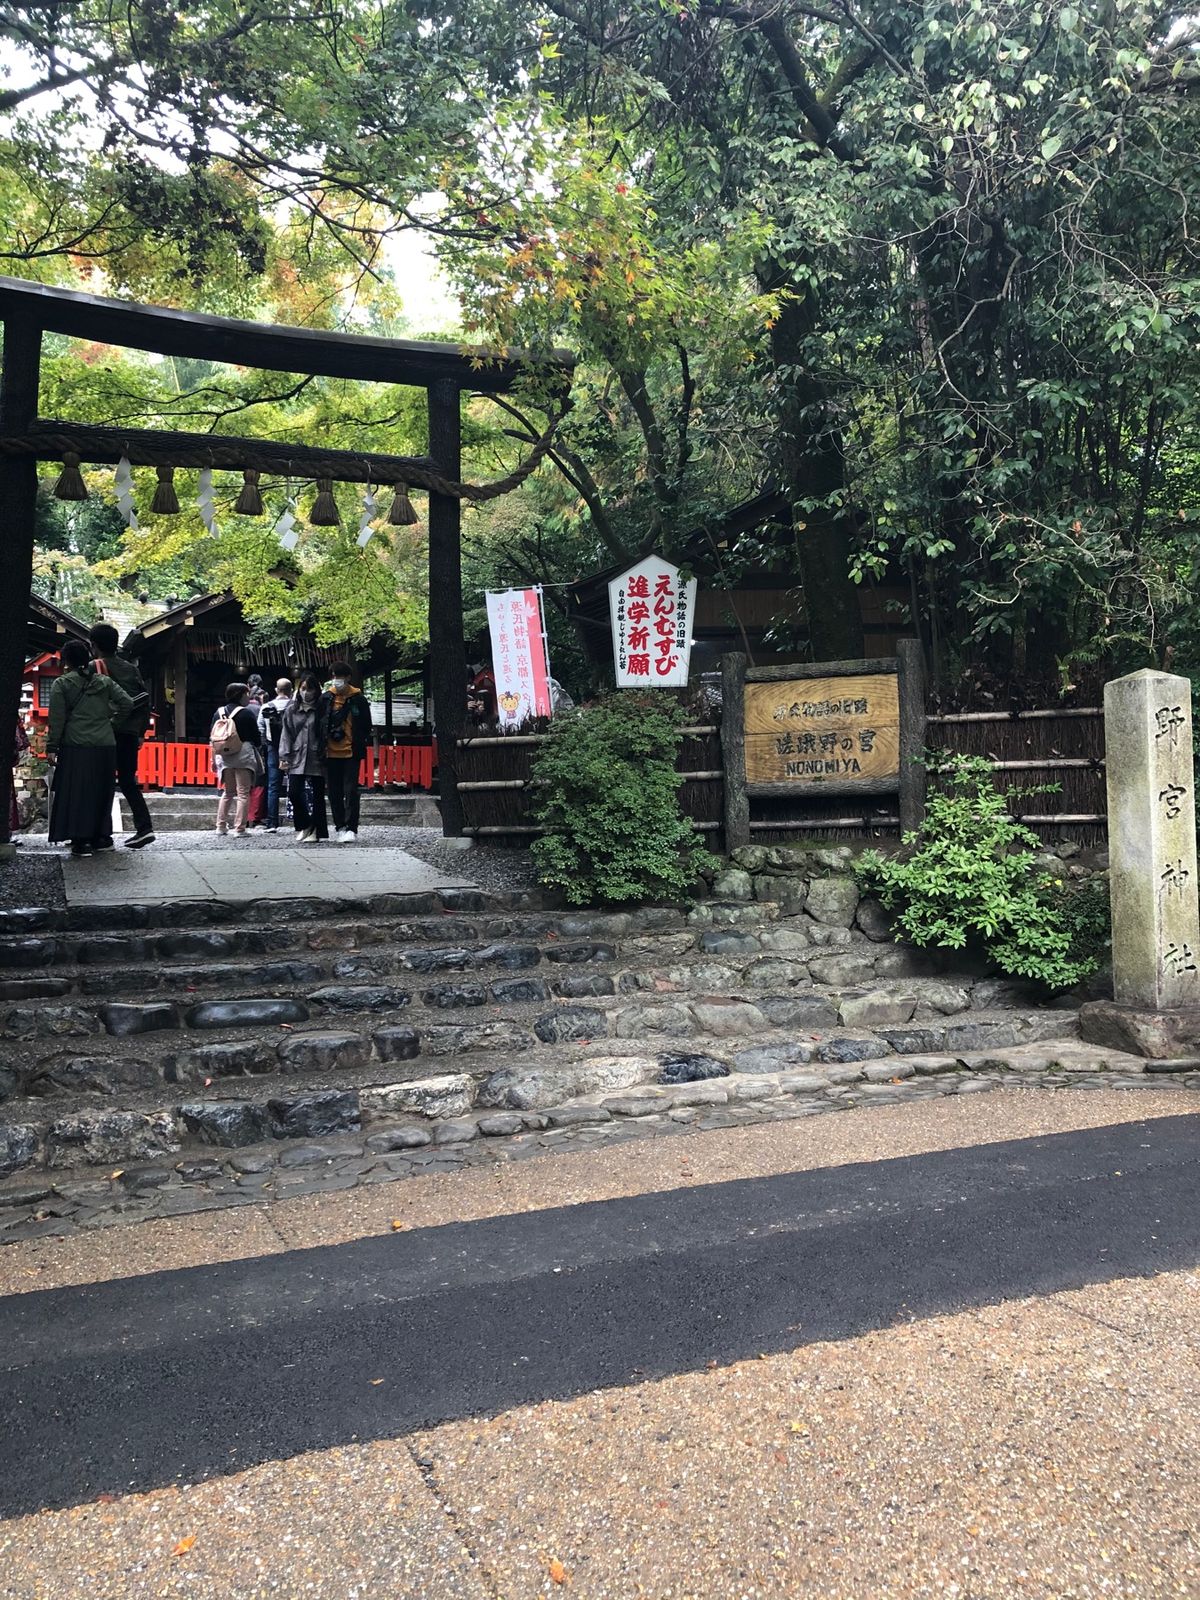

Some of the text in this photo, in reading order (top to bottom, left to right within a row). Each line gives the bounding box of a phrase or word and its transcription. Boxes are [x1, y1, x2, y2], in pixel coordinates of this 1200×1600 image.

[627, 575, 651, 676] 進学祈願
[653, 575, 679, 676] えんむすび
[786, 758, 861, 776] NONOMIYA
[1155, 706, 1197, 977] 野宮神社
